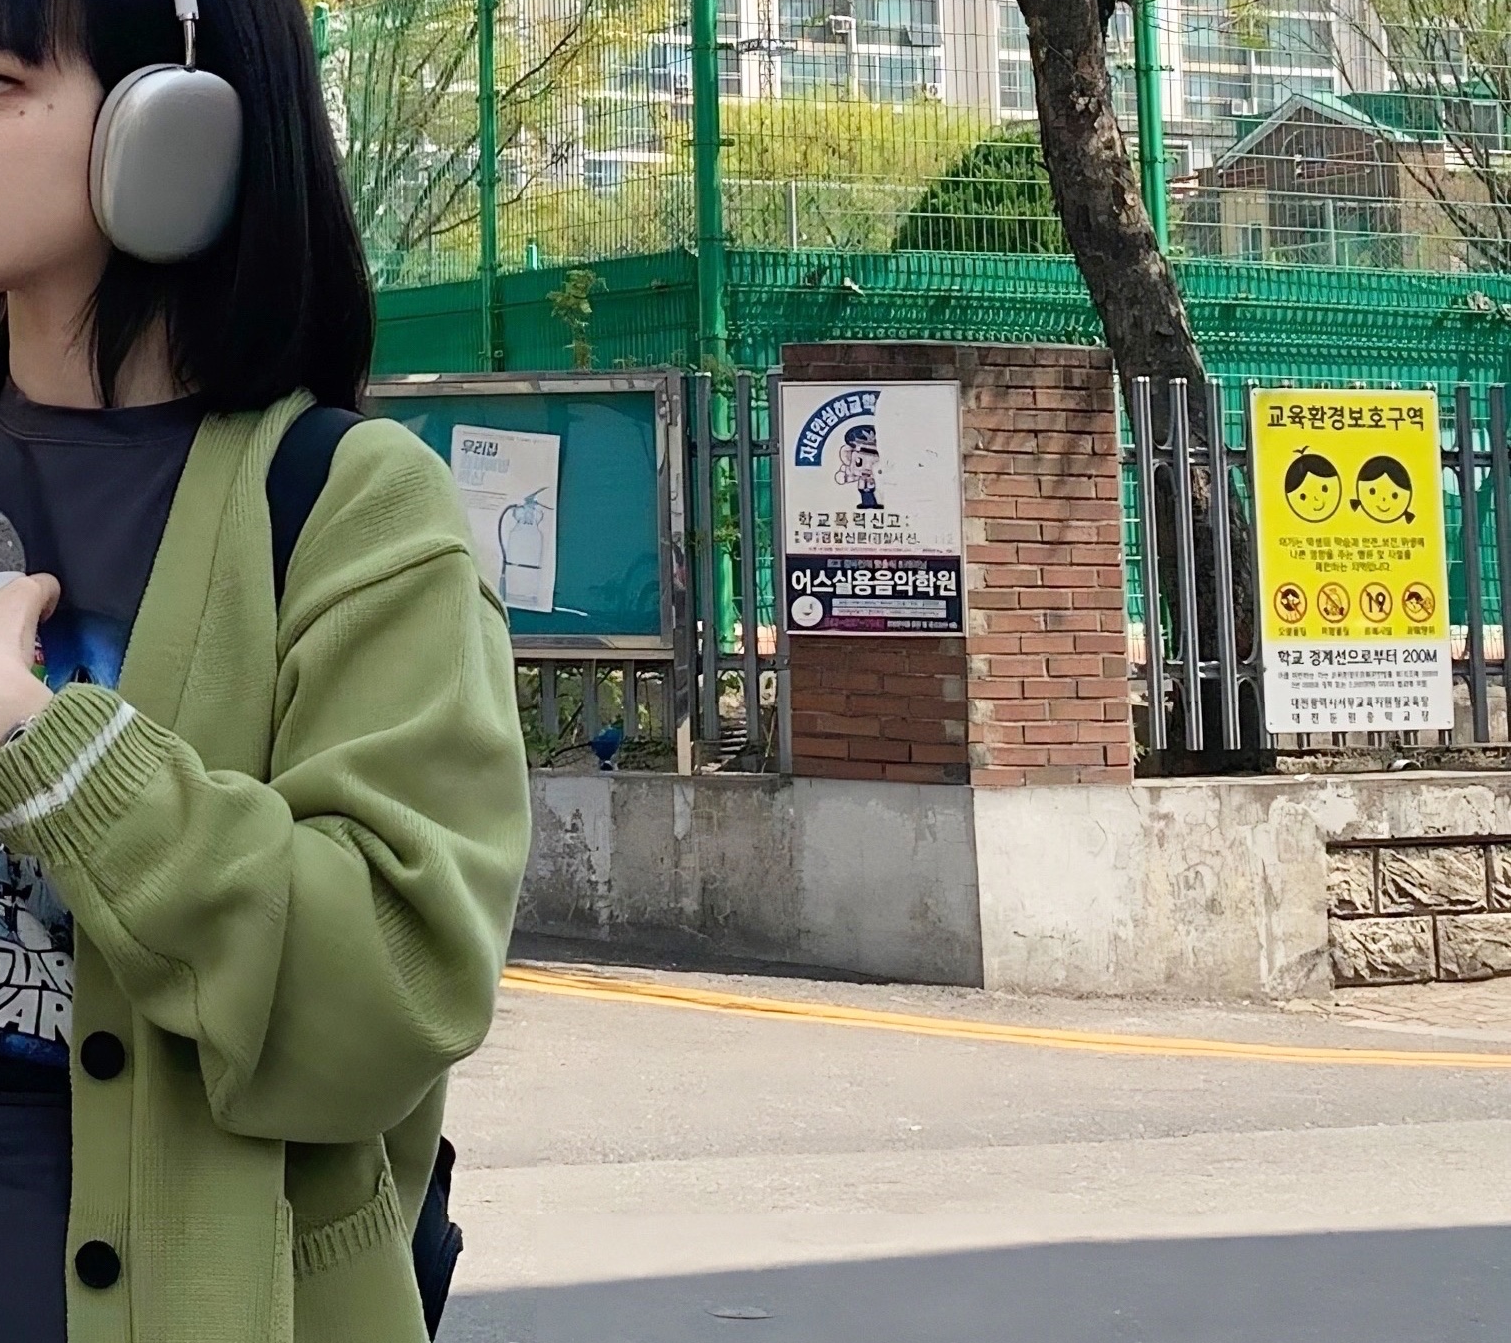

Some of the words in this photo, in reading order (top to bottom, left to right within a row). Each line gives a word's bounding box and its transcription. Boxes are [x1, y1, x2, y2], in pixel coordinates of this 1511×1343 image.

[1267, 404, 1424, 432] 교육환경보호구역
[791, 568, 958, 597] 어스실용음악학원
[1277, 649, 1305, 667] 학교
[1309, 649, 1398, 667] 경계선으로부터
[1402, 648, 1438, 664] 200M
